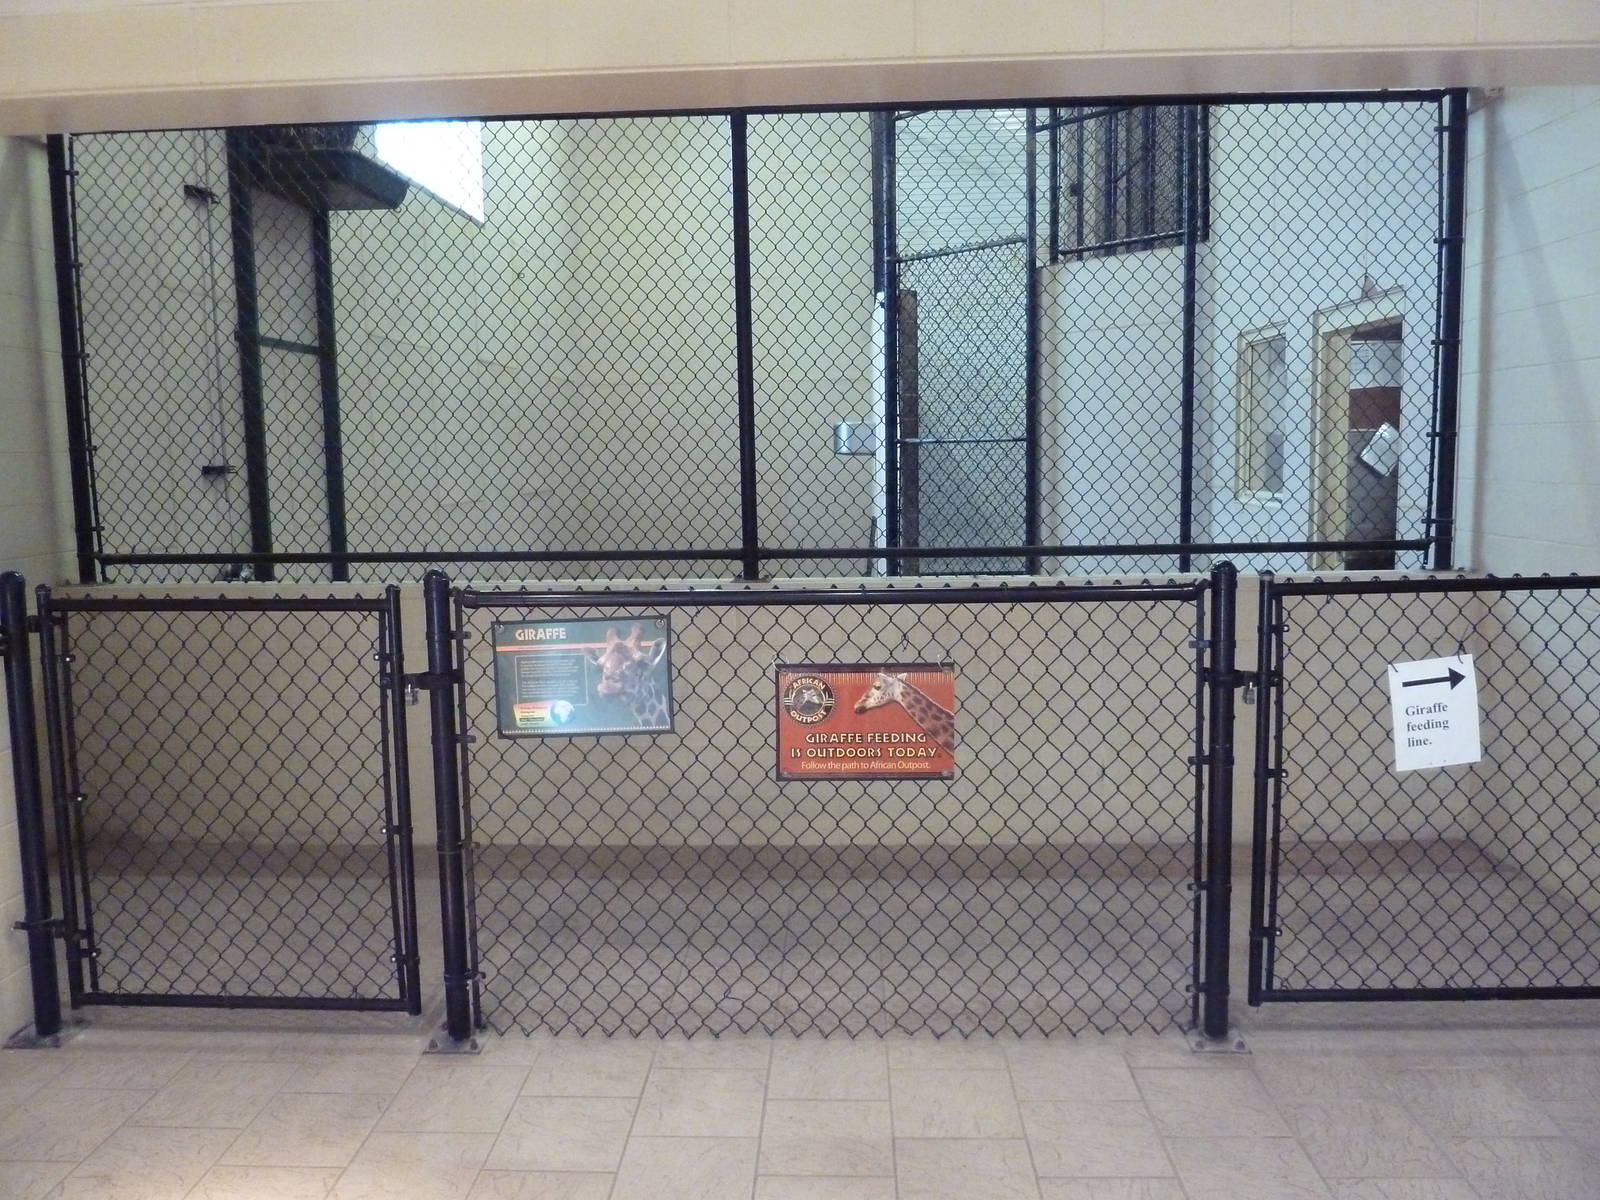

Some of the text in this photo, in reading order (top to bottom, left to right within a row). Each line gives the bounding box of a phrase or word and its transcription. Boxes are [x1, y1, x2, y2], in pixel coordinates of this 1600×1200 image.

[515, 627, 567, 641] GIRAFFE
[792, 678, 826, 690] AFRICAN
[790, 709, 827, 723] OUTPOST
[1405, 703, 1448, 717] Giraffe
[1407, 719, 1450, 732] feeding
[805, 733, 927, 743] GIRAFFE FEEDING
[1407, 737, 1433, 748] line.
[791, 747, 801, 758] IS
[806, 747, 882, 758] OUTDOORS
[801, 761, 827, 770] Follow
[828, 761, 841, 770] the
[842, 761, 859, 771] path
[869, 761, 897, 770] African
[898, 761, 930, 771] Outpost.
